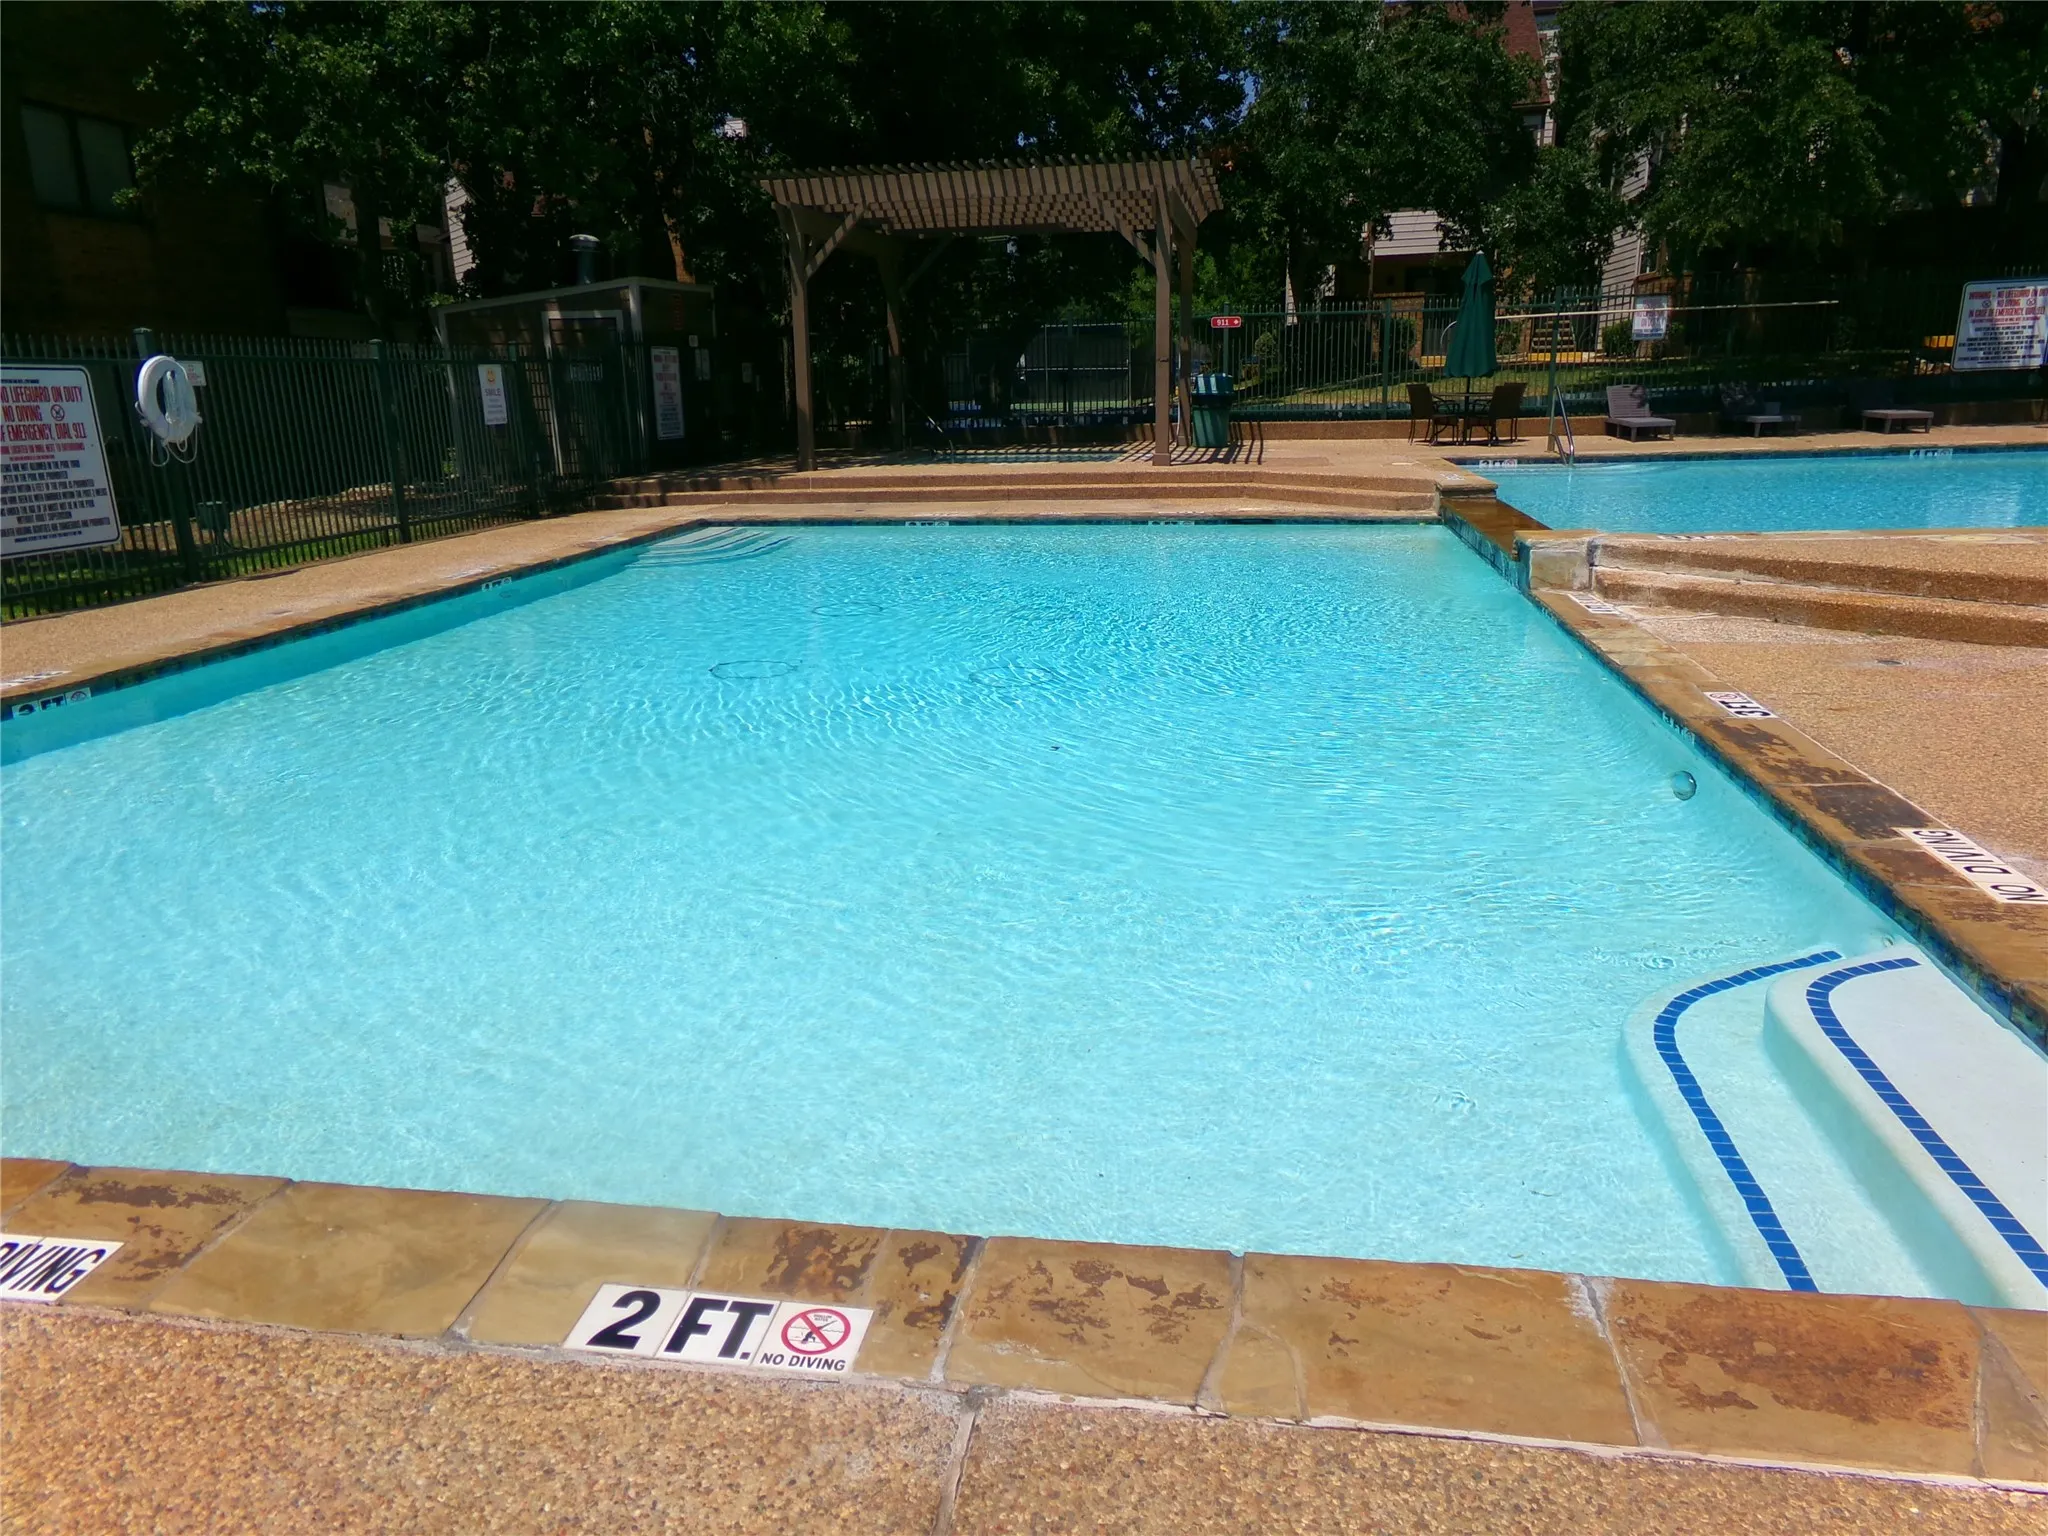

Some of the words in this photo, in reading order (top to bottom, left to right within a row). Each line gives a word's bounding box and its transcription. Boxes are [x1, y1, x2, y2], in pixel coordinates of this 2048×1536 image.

[1216, 318, 1229, 326] 911
[10, 386, 50, 403] LIFEGUARD
[51, 386, 63, 402] ON
[63, 386, 83, 402] DUTY
[484, 388, 501, 397] SMILE
[2, 405, 15, 422] NO
[16, 405, 42, 421] DIVING
[7, 424, 55, 442] EMERGENCY,
[55, 424, 72, 439] DIAL
[1912, 830, 2013, 875] DIVING
[1990, 884, 2048, 902] NO
[585, 1290, 661, 1350] 2
[663, 1297, 774, 1361] FT.
[759, 1352, 785, 1366] NO
[787, 1355, 846, 1372] DIVING
